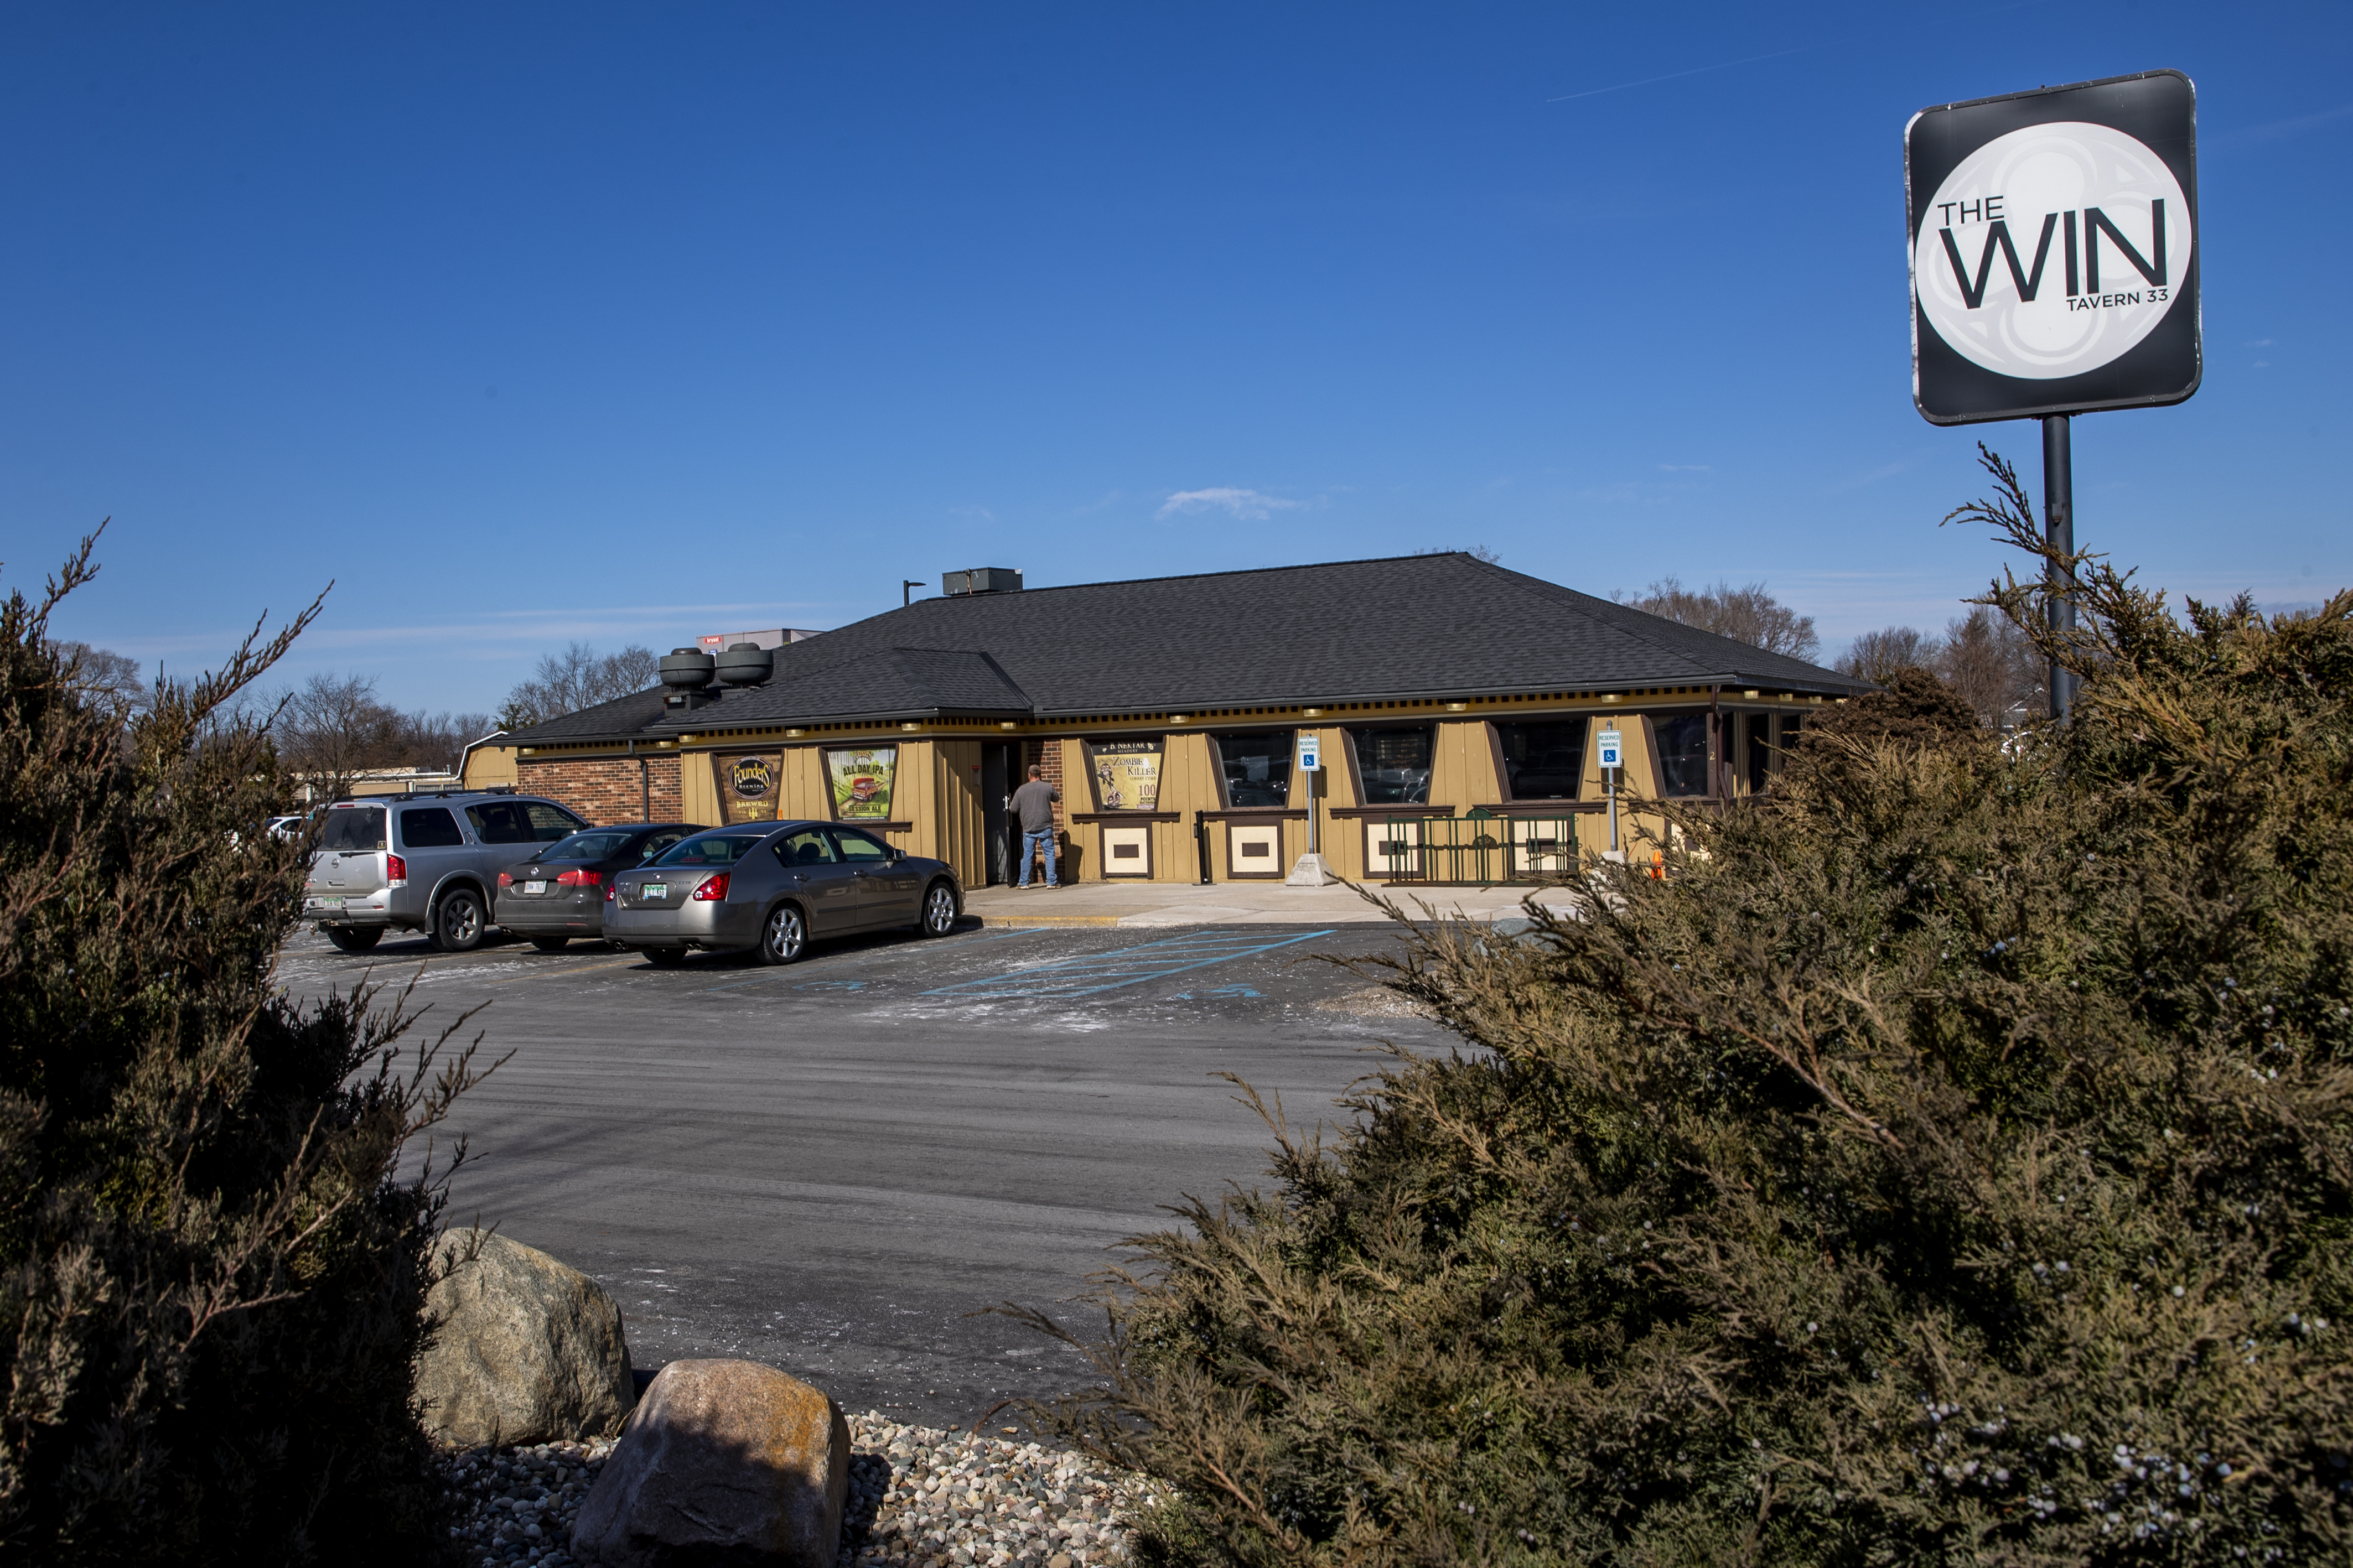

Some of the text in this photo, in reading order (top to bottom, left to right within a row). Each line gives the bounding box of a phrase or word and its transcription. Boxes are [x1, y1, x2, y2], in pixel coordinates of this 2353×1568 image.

[1937, 195, 2005, 226] THE
[1939, 199, 2168, 309] WIN
[2066, 288, 2168, 311] TAVERN 33
[734, 762, 770, 787] Founders
[843, 764, 884, 776] ALL DAY IPA
[1139, 784, 1156, 796] 100
